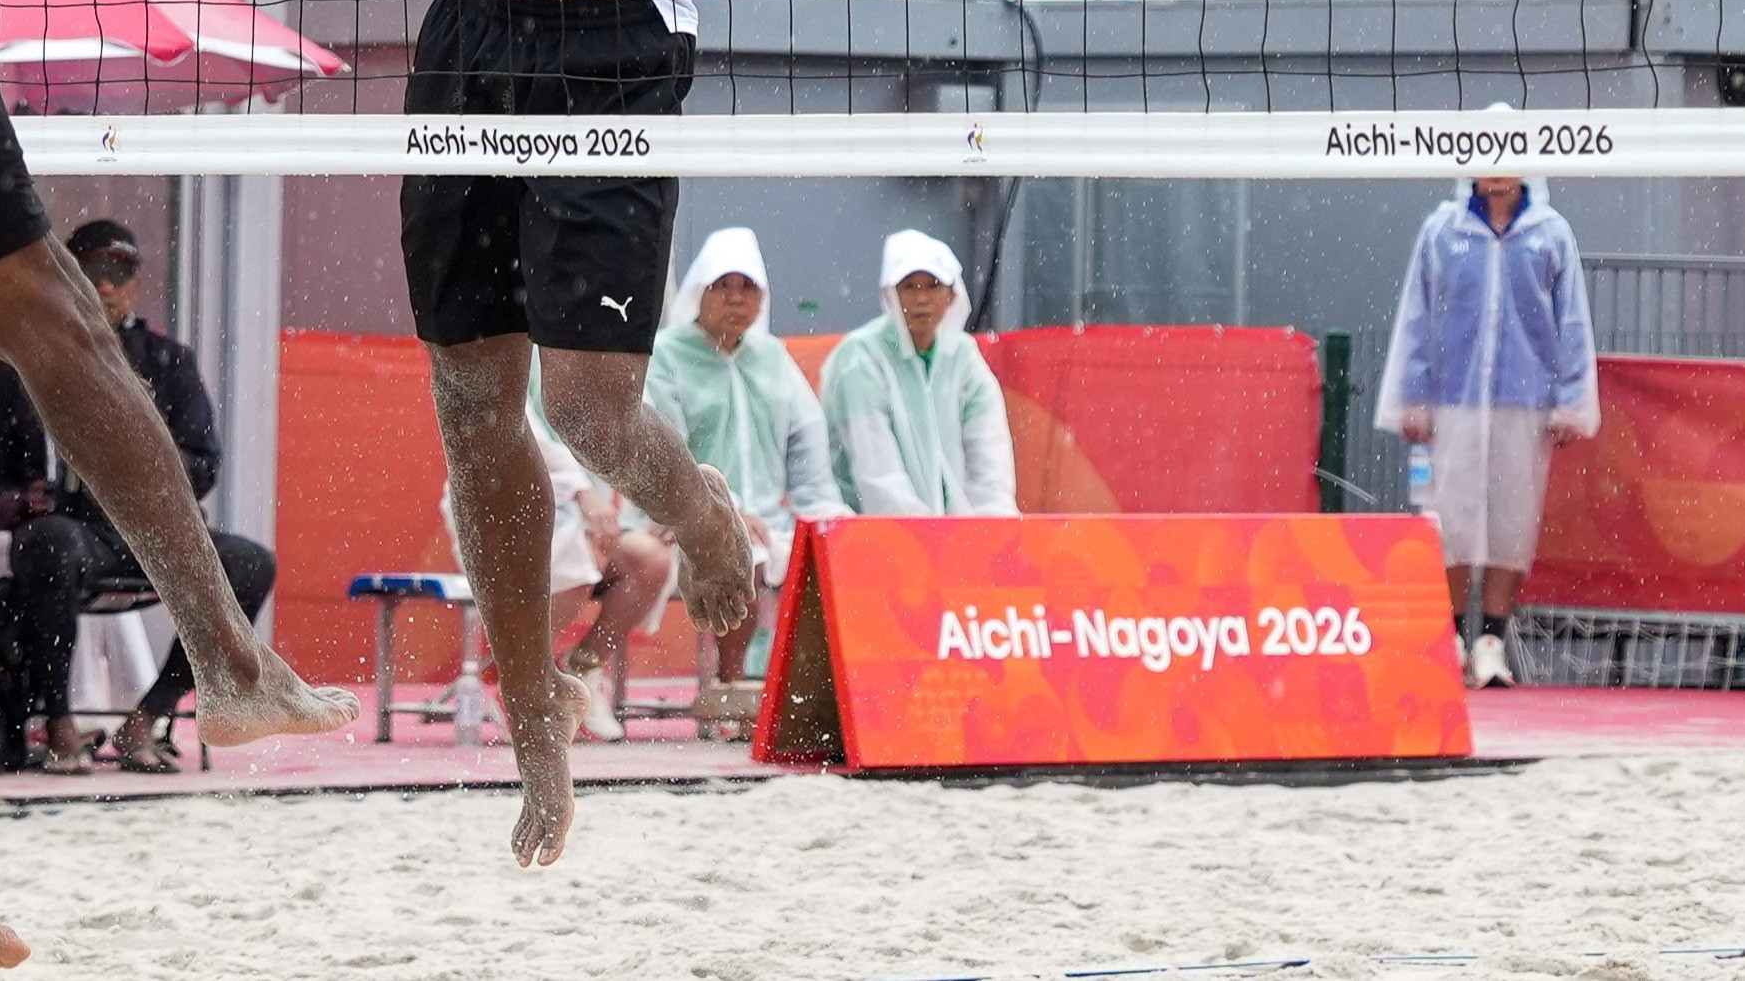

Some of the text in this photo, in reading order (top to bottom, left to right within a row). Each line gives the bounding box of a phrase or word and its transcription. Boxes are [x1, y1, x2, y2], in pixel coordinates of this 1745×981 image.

[406, 124, 650, 165] Aichi-Nagoya 2026
[1326, 123, 1613, 165] Aichi-Nagoya 2026
[937, 603, 1373, 673] Aichi-Nagoya 2026
